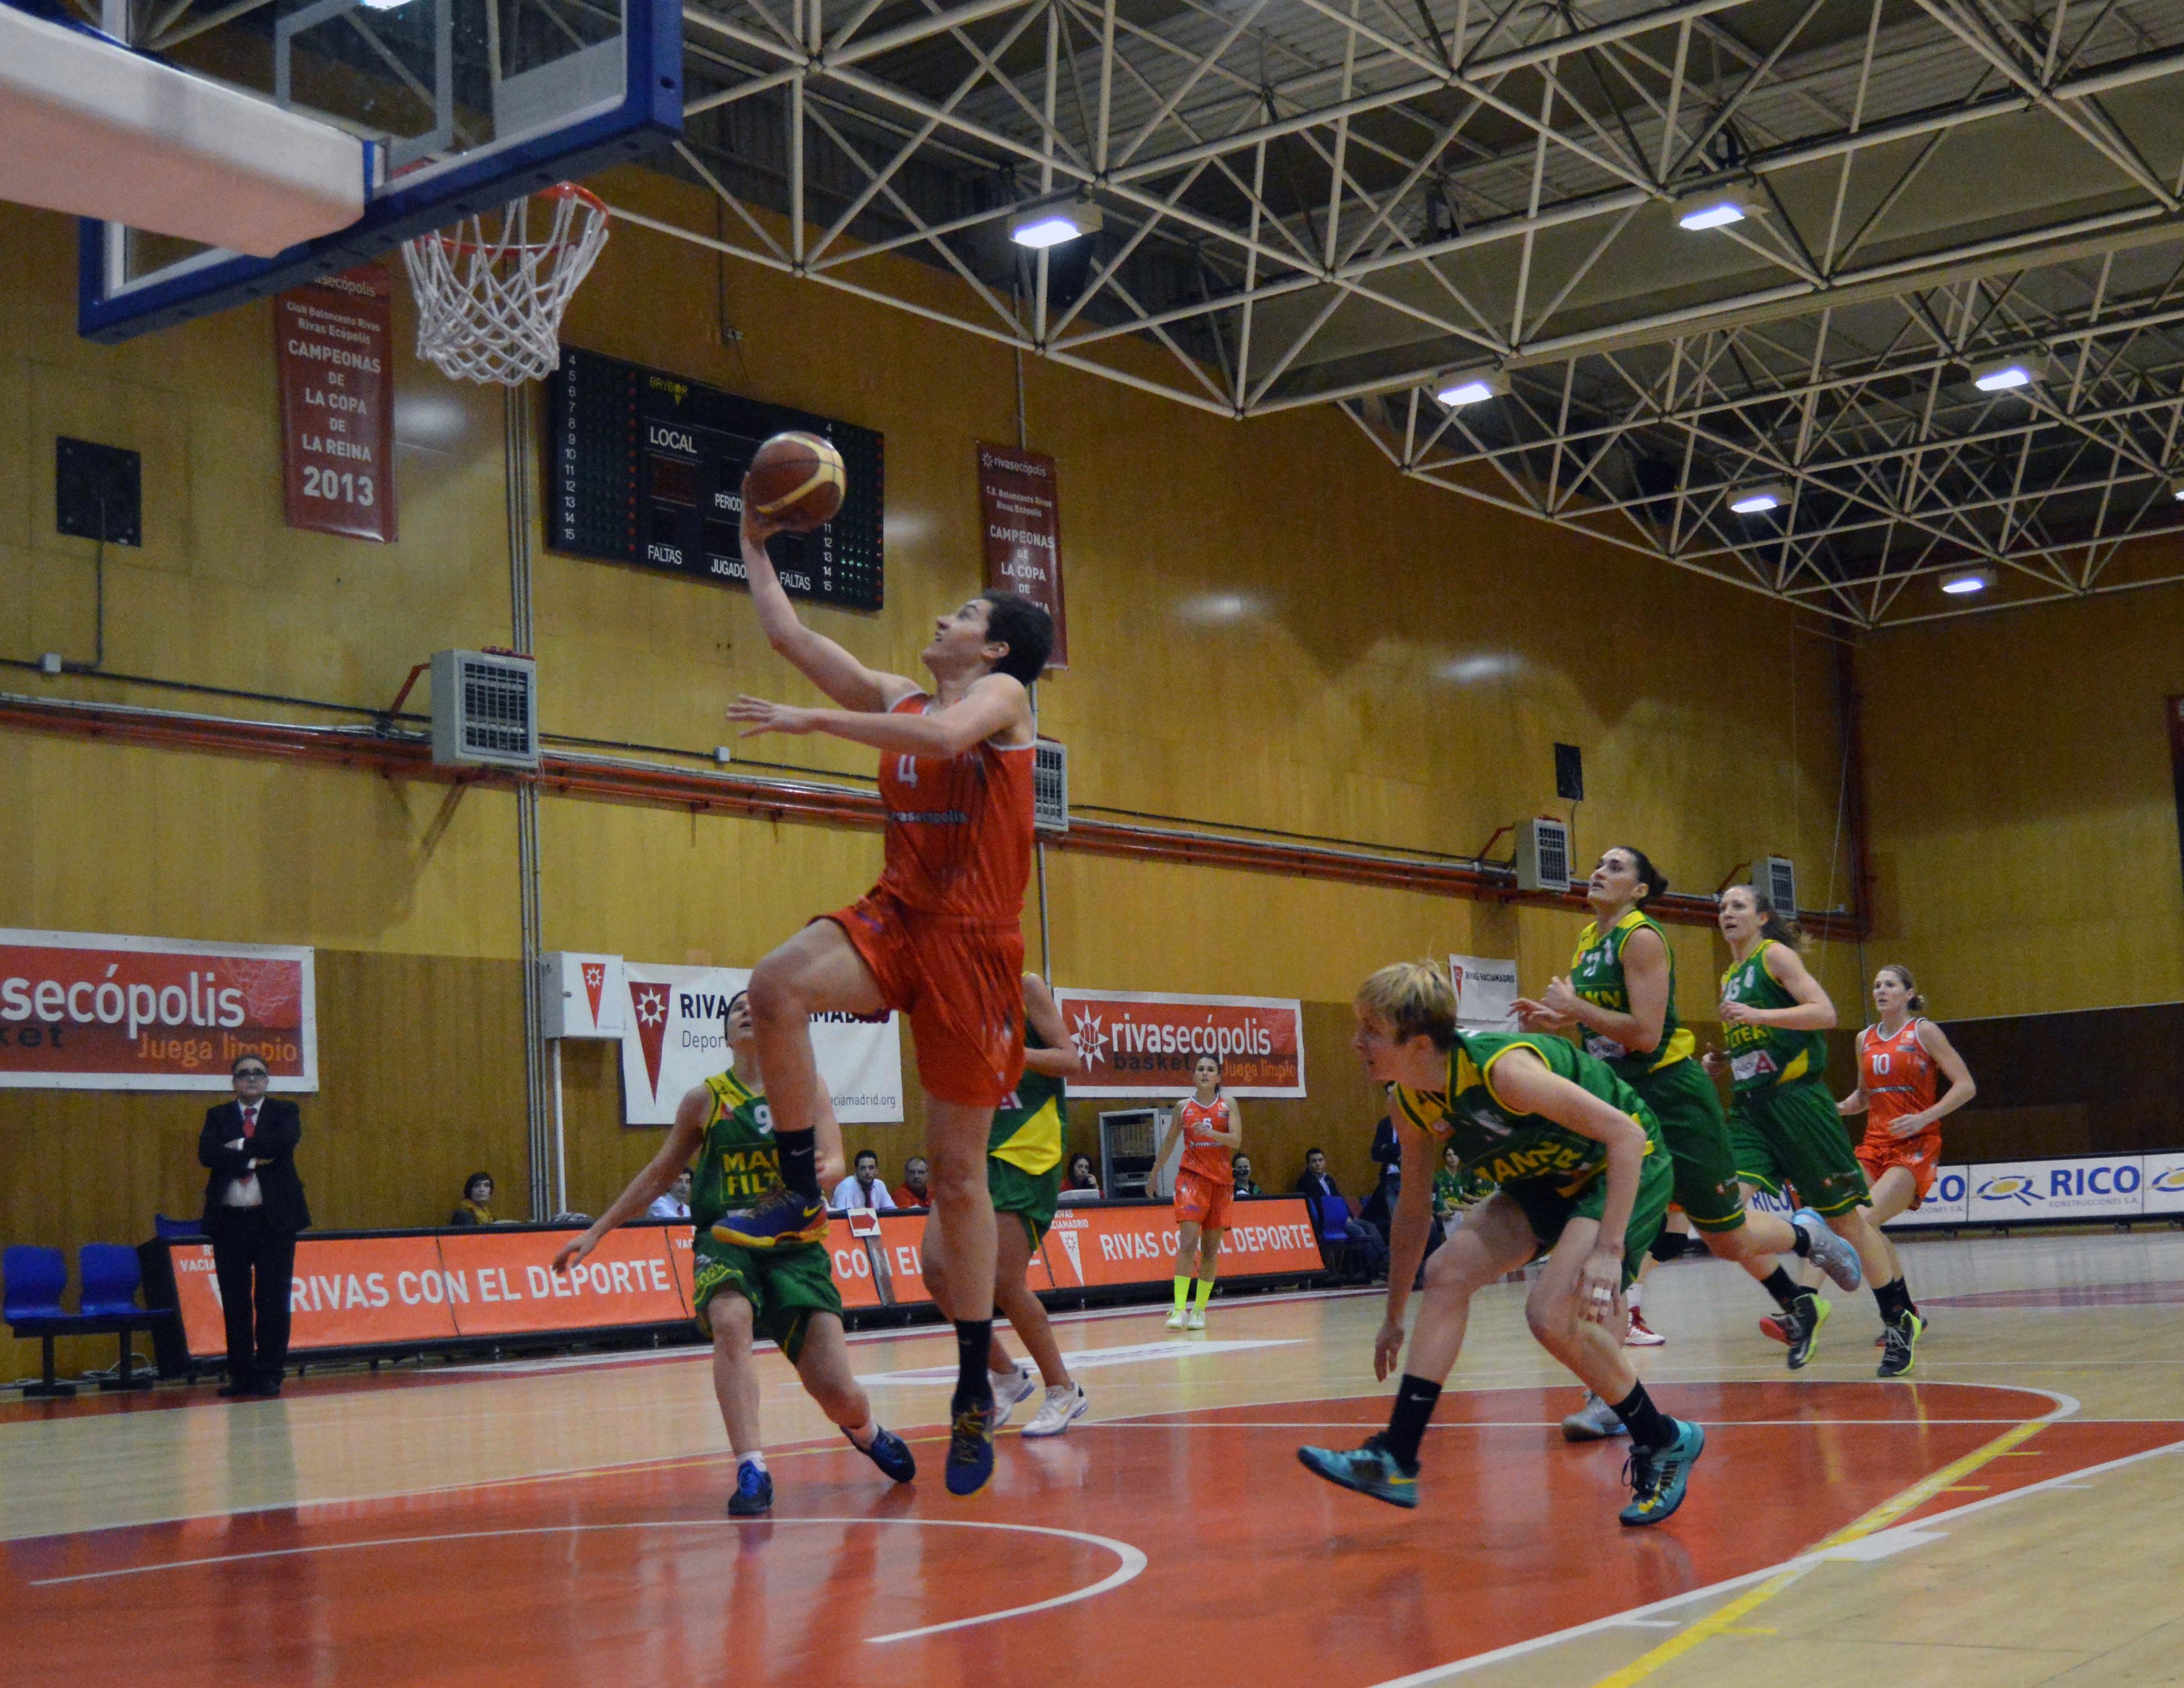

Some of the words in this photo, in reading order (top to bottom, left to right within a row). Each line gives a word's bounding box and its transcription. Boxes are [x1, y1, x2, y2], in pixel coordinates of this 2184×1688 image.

[286, 301, 307, 314] Club
[309, 306, 356, 326] Baloncesto
[358, 318, 381, 332] Rivas
[298, 317, 327, 334] Rivas
[288, 339, 381, 374] CAMPEONAS
[569, 354, 576, 365] 4
[328, 371, 344, 387] DE
[568, 370, 576, 381] 5
[568, 386, 576, 397] 6
[305, 387, 325, 407] LA
[328, 392, 367, 415] COPA
[568, 401, 576, 413] 7
[329, 417, 346, 433] DE
[568, 418, 576, 429] 8
[826, 423, 832, 433] 4
[568, 433, 576, 445] 9
[650, 425, 697, 454] LOCAL
[302, 433, 322, 452] LA
[325, 438, 372, 462] REINA
[564, 447, 576, 460] 10
[564, 464, 574, 476] 11
[994, 456, 1047, 477] rivasecópolis
[303, 465, 375, 507] 2013
[564, 480, 576, 492] 12
[564, 496, 576, 508] 13
[564, 512, 575, 524] 14
[564, 528, 575, 540] 15
[990, 524, 1055, 549] CAMPEONAS
[823, 537, 832, 548] 12
[648, 544, 683, 565] FALTAS
[823, 552, 832, 562] 13
[1017, 548, 1029, 559] DE
[711, 558, 749, 580] JUGADO
[823, 566, 832, 576] 14
[1001, 561, 1015, 577] LA
[1017, 564, 1047, 582] COPA
[779, 571, 811, 591] FALTAS
[823, 581, 832, 591] 15
[1018, 583, 1031, 594] DE
[1112, 1013, 1272, 1064] rivasecópolis
[137, 1032, 213, 1068] Juega
[1872, 1053, 1890, 1076] 10
[754, 1104, 773, 1134] 9
[2050, 1165, 2140, 1197] RICO
[2048, 1198, 2121, 1209] CONSTRUCCIONES
[1099, 1231, 1160, 1261] RIVAS
[1232, 1224, 1315, 1253] DEPORTE
[290, 1272, 390, 1312] RIVAS
[397, 1269, 470, 1306] CON
[477, 1267, 523, 1302] EL
[526, 1258, 670, 1299] DEPORTE
